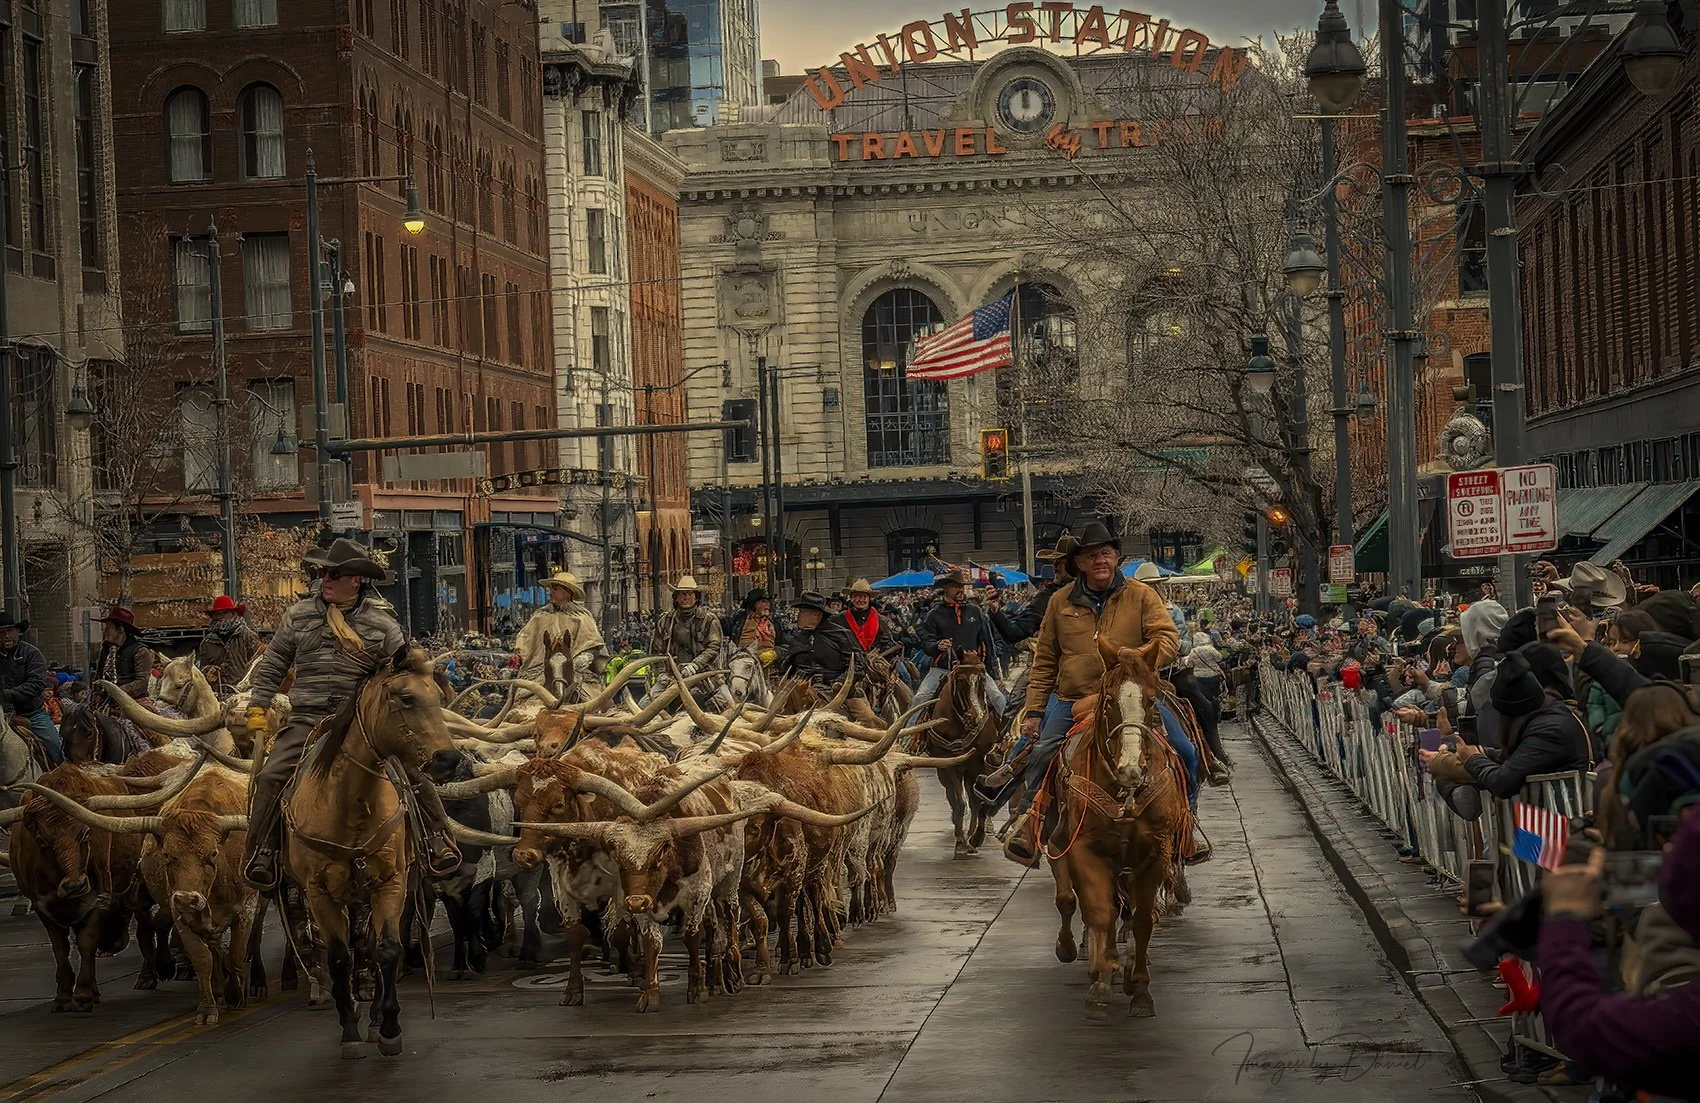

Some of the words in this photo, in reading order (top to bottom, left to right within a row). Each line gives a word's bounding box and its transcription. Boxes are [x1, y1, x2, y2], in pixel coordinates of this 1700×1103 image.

[804, 8, 978, 110] UNION
[1006, 1, 1247, 94] STATION
[832, 126, 1006, 162] TRAVEL
[1044, 122, 1082, 161] by
[1519, 471, 1537, 487] NO
